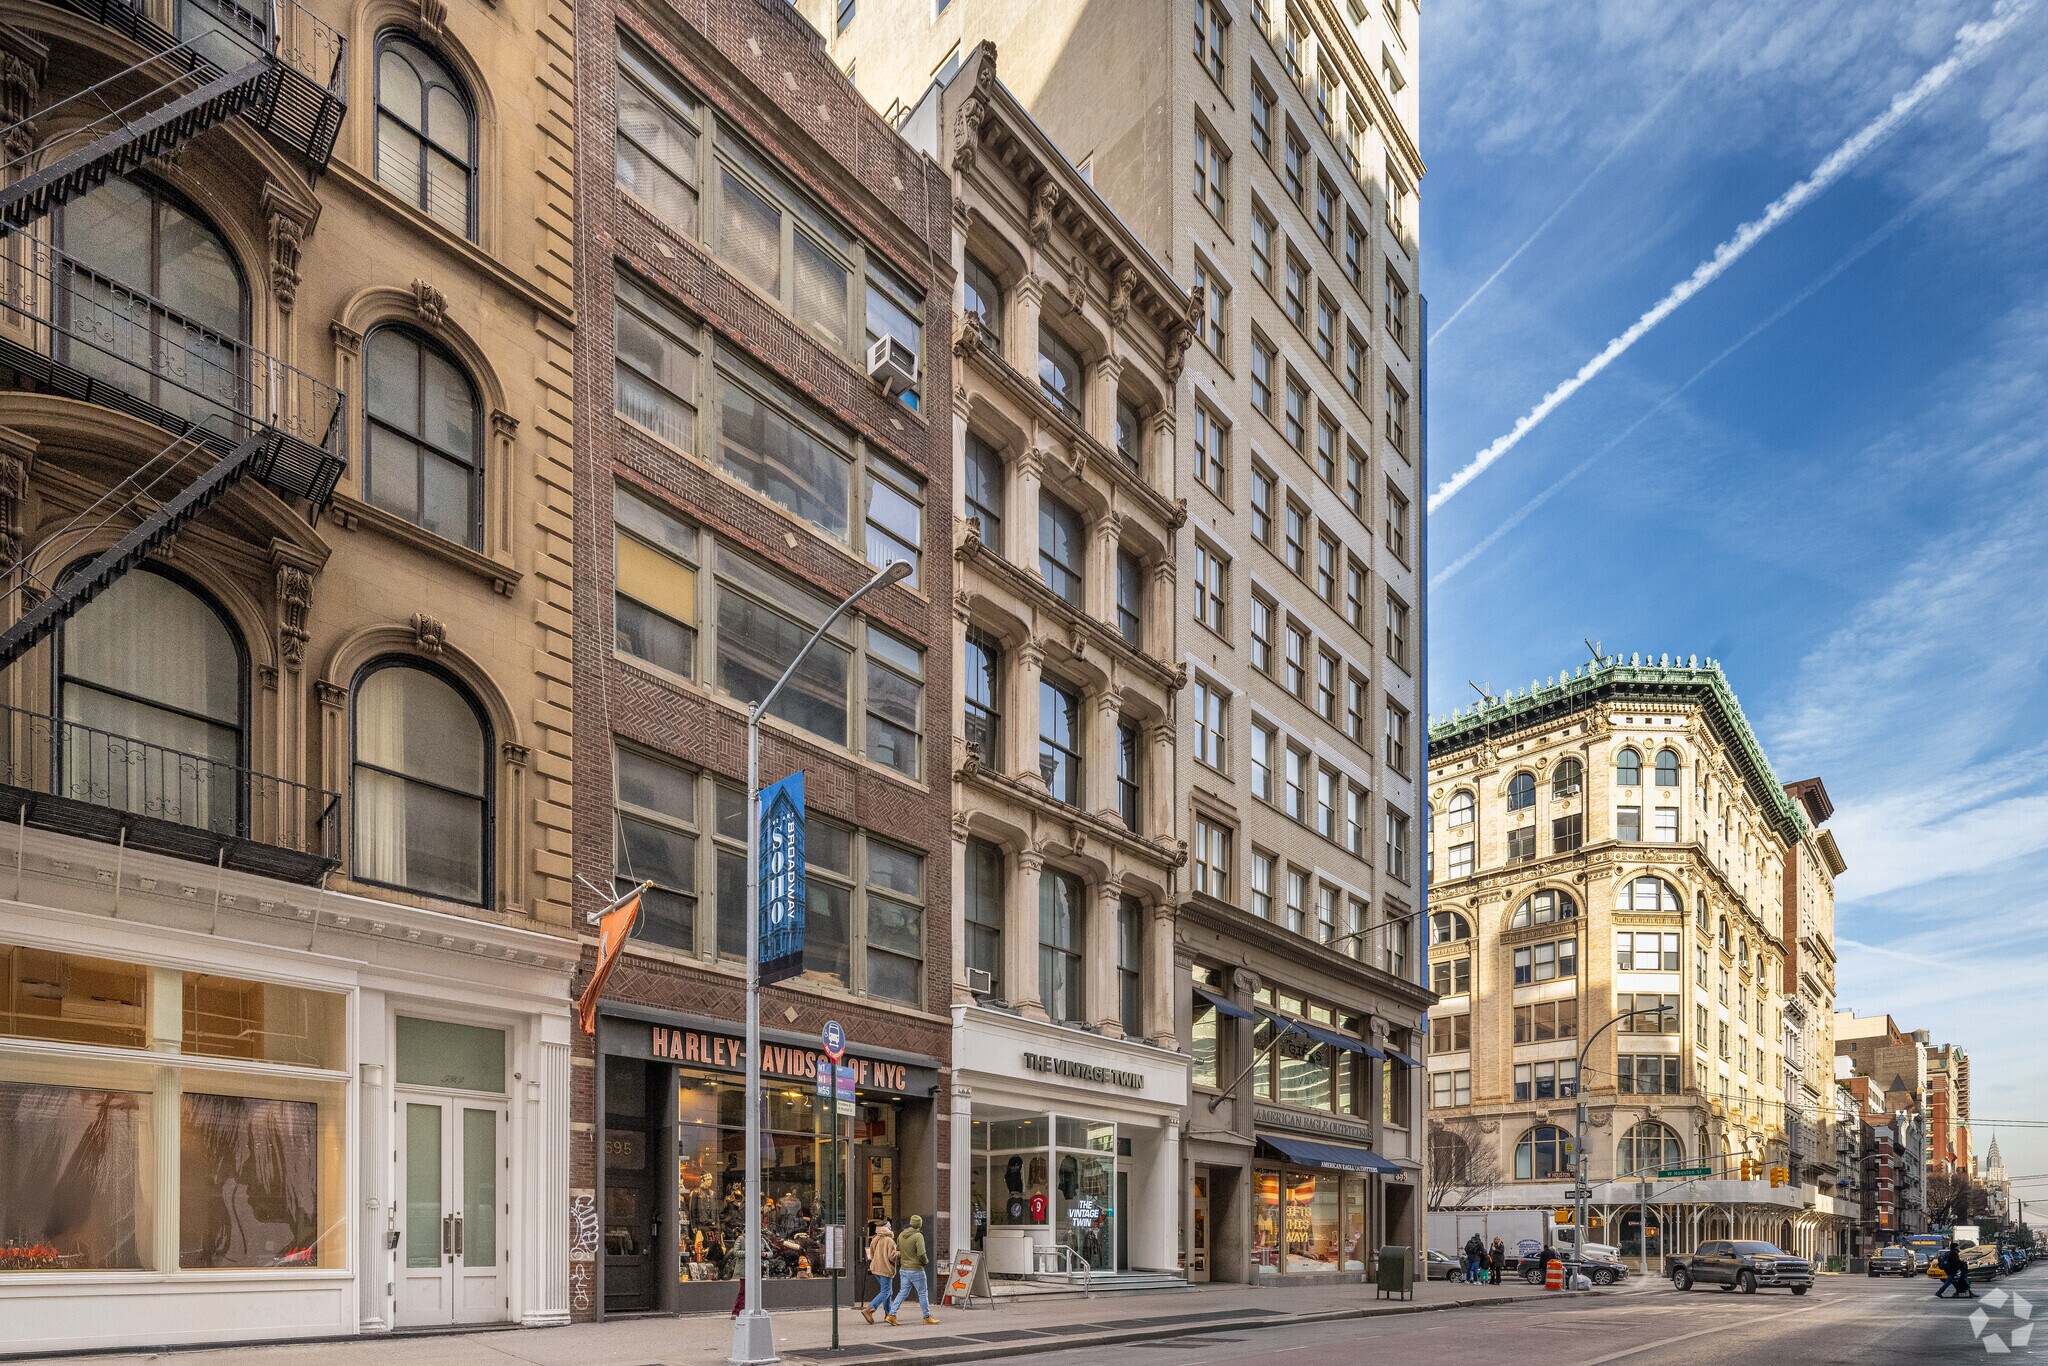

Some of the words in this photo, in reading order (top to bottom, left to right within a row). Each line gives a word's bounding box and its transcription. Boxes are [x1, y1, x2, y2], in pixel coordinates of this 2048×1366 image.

[782, 811, 795, 821] ARE
[771, 825, 786, 925] SOHO
[787, 821, 796, 919] BROADWAY
[653, 1027, 842, 1078] HARLEY-AVIDS
[873, 1062, 906, 1091] NYC
[1024, 1052, 1052, 1073] THE
[1053, 1058, 1110, 1083] VINTAGE
[1110, 1069, 1145, 1089] TWIN
[1255, 1108, 1302, 1127] AMERICAN
[1303, 1117, 1329, 1131] EAGLE
[1329, 1121, 1374, 1139] OUTFITTERS
[605, 1141, 632, 1156] 595
[1321, 1161, 1343, 1169] AMERICAN
[1355, 1165, 1379, 1173] OUTFITTERS
[1036, 1201, 1042, 1213] 9
[1078, 1200, 1093, 1210] THE
[1286, 1205, 1312, 1217] GIFTS
[1068, 1209, 1100, 1218] VINTAGE
[1072, 1218, 1092, 1227] TWIN
